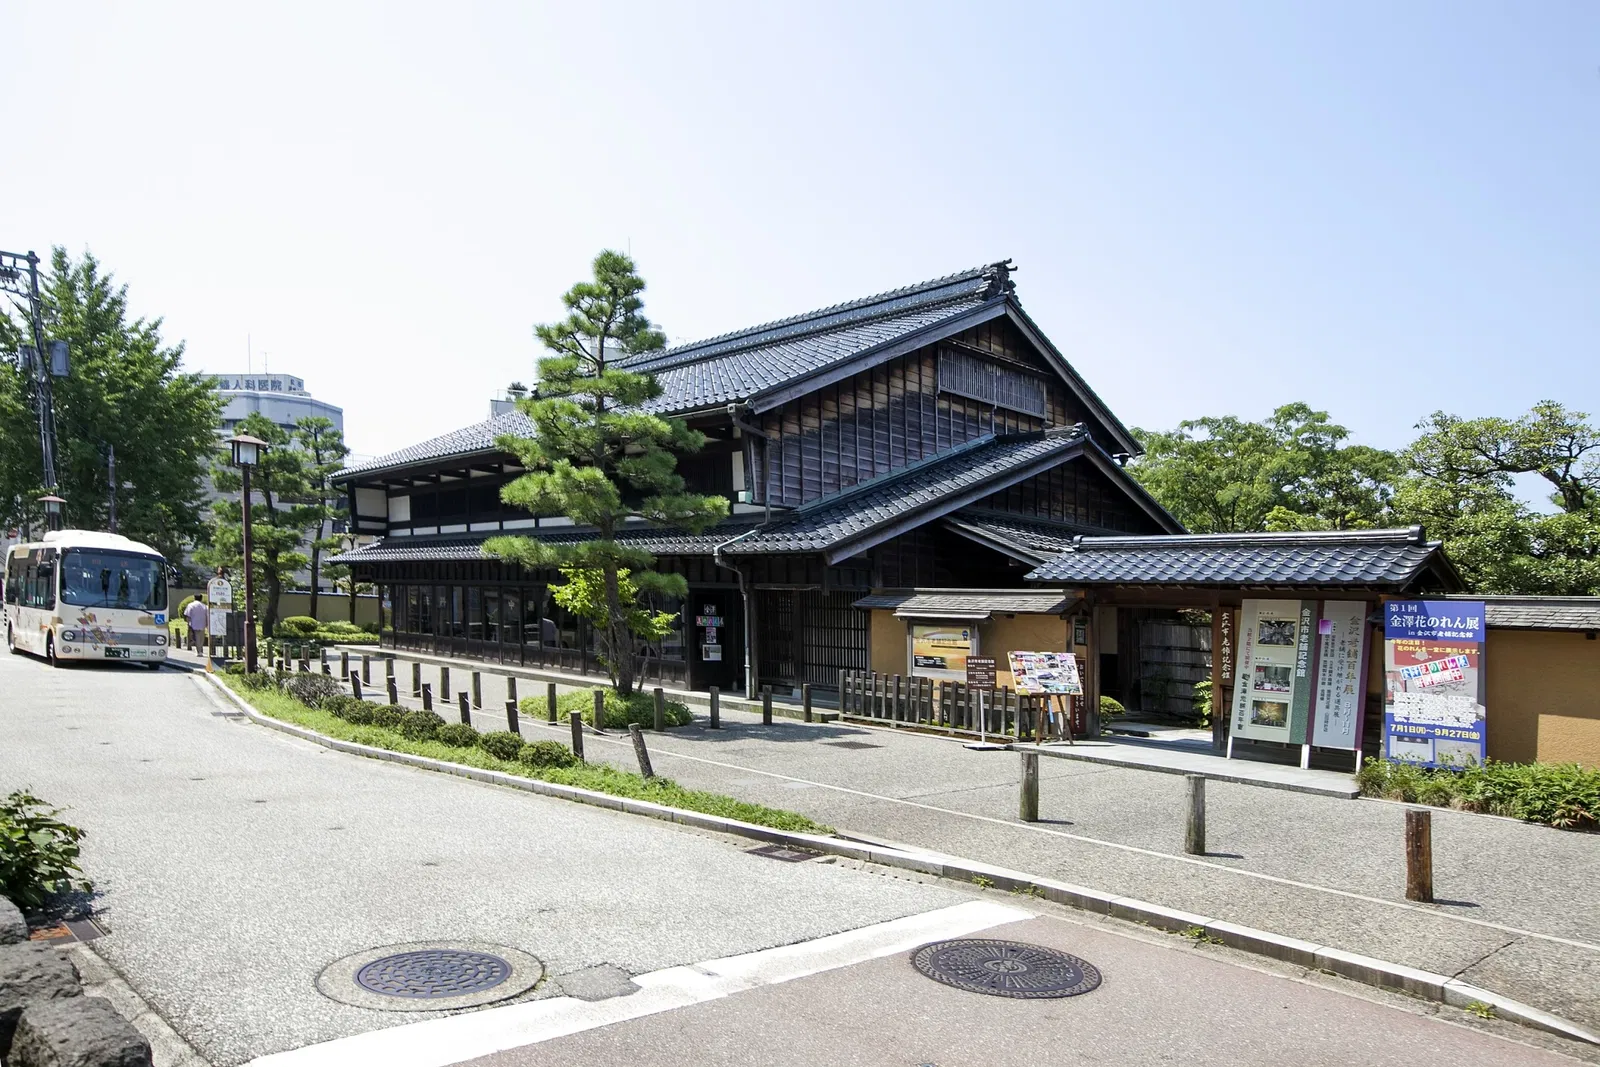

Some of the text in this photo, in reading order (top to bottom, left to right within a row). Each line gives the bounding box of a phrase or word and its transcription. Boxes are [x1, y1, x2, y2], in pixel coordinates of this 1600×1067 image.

[1296, 608, 1311, 678] 金沢市老舗記念館
[1389, 614, 1480, 630] 金澤花のれん展
